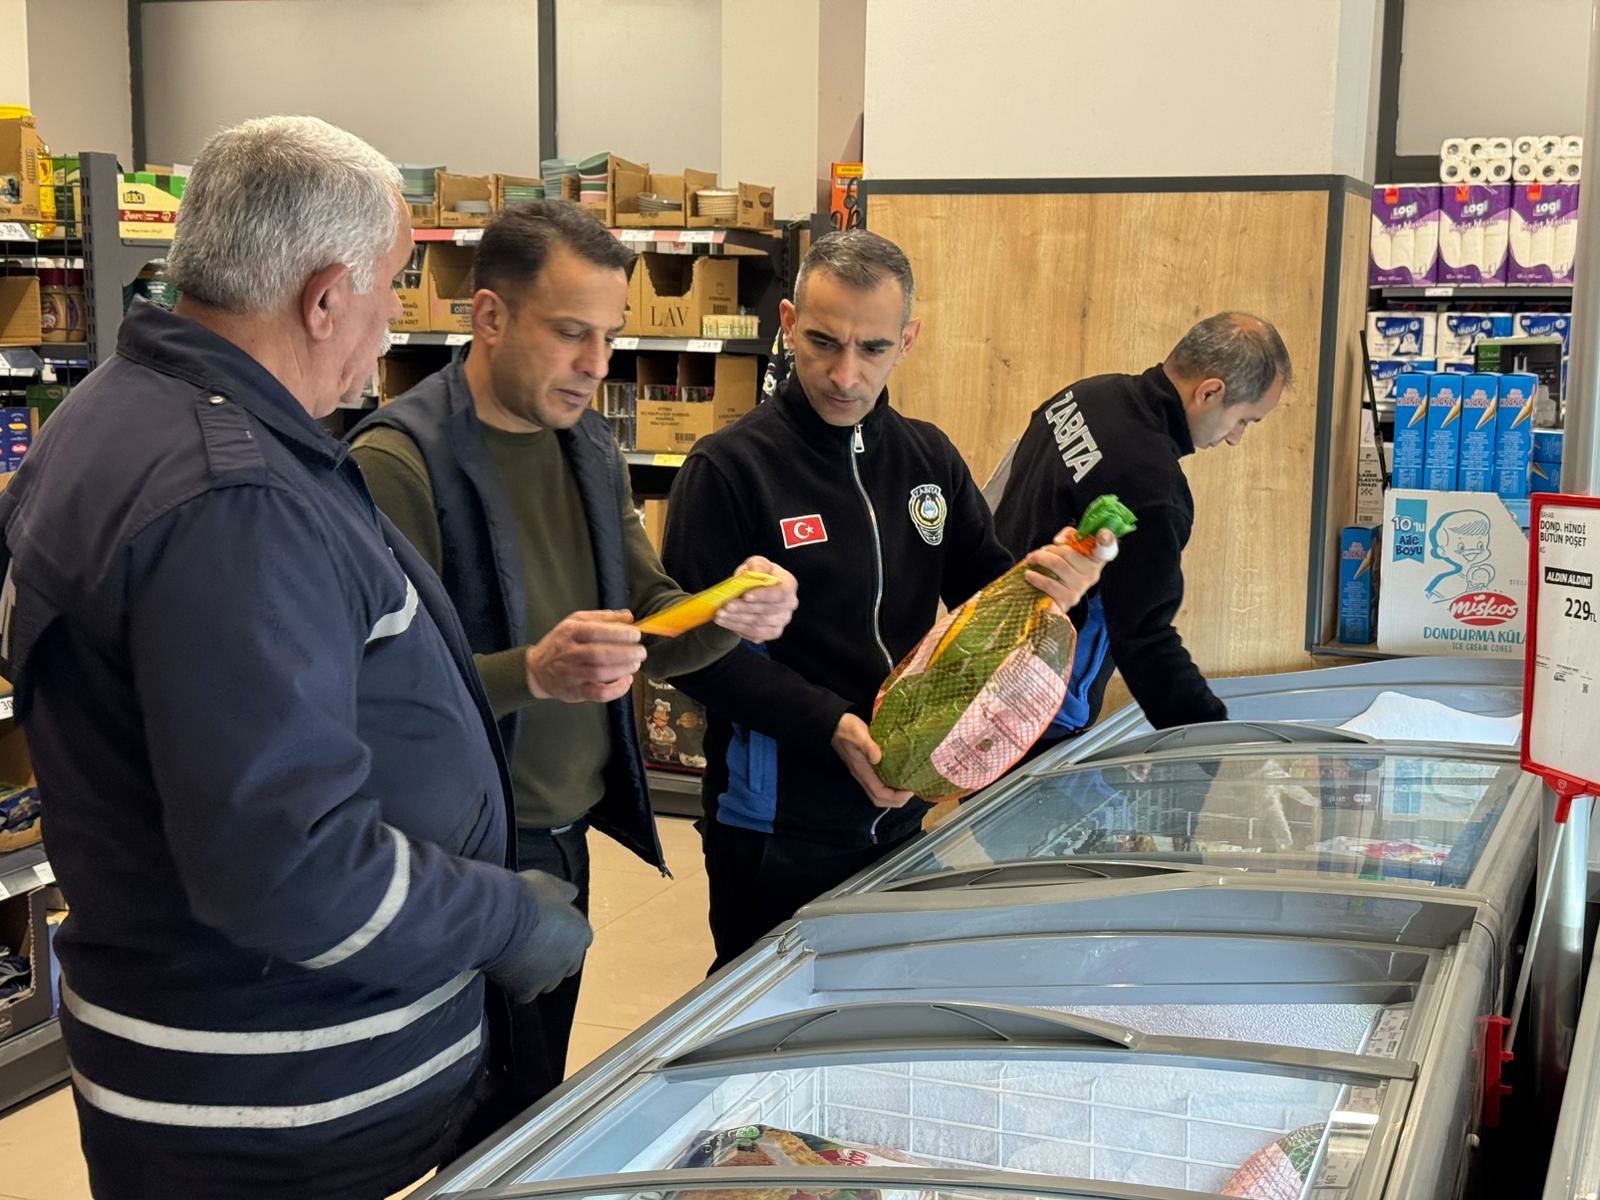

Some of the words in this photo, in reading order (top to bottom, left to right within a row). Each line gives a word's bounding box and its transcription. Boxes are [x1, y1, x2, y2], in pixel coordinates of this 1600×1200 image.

[1392, 202, 1418, 218] Logi
[1463, 200, 1488, 216] Logi
[1535, 199, 1561, 215] Logi
[651, 305, 688, 327] LAV
[1045, 390, 1103, 483] ZABITA
[1400, 535, 1420, 546] Aile
[1396, 545, 1423, 556] Boyu
[1546, 571, 1568, 582] ALDIN
[1423, 626, 1495, 643] DONDURMA
[1466, 643, 1488, 652] CREAM
[1491, 645, 1512, 653] CONES
